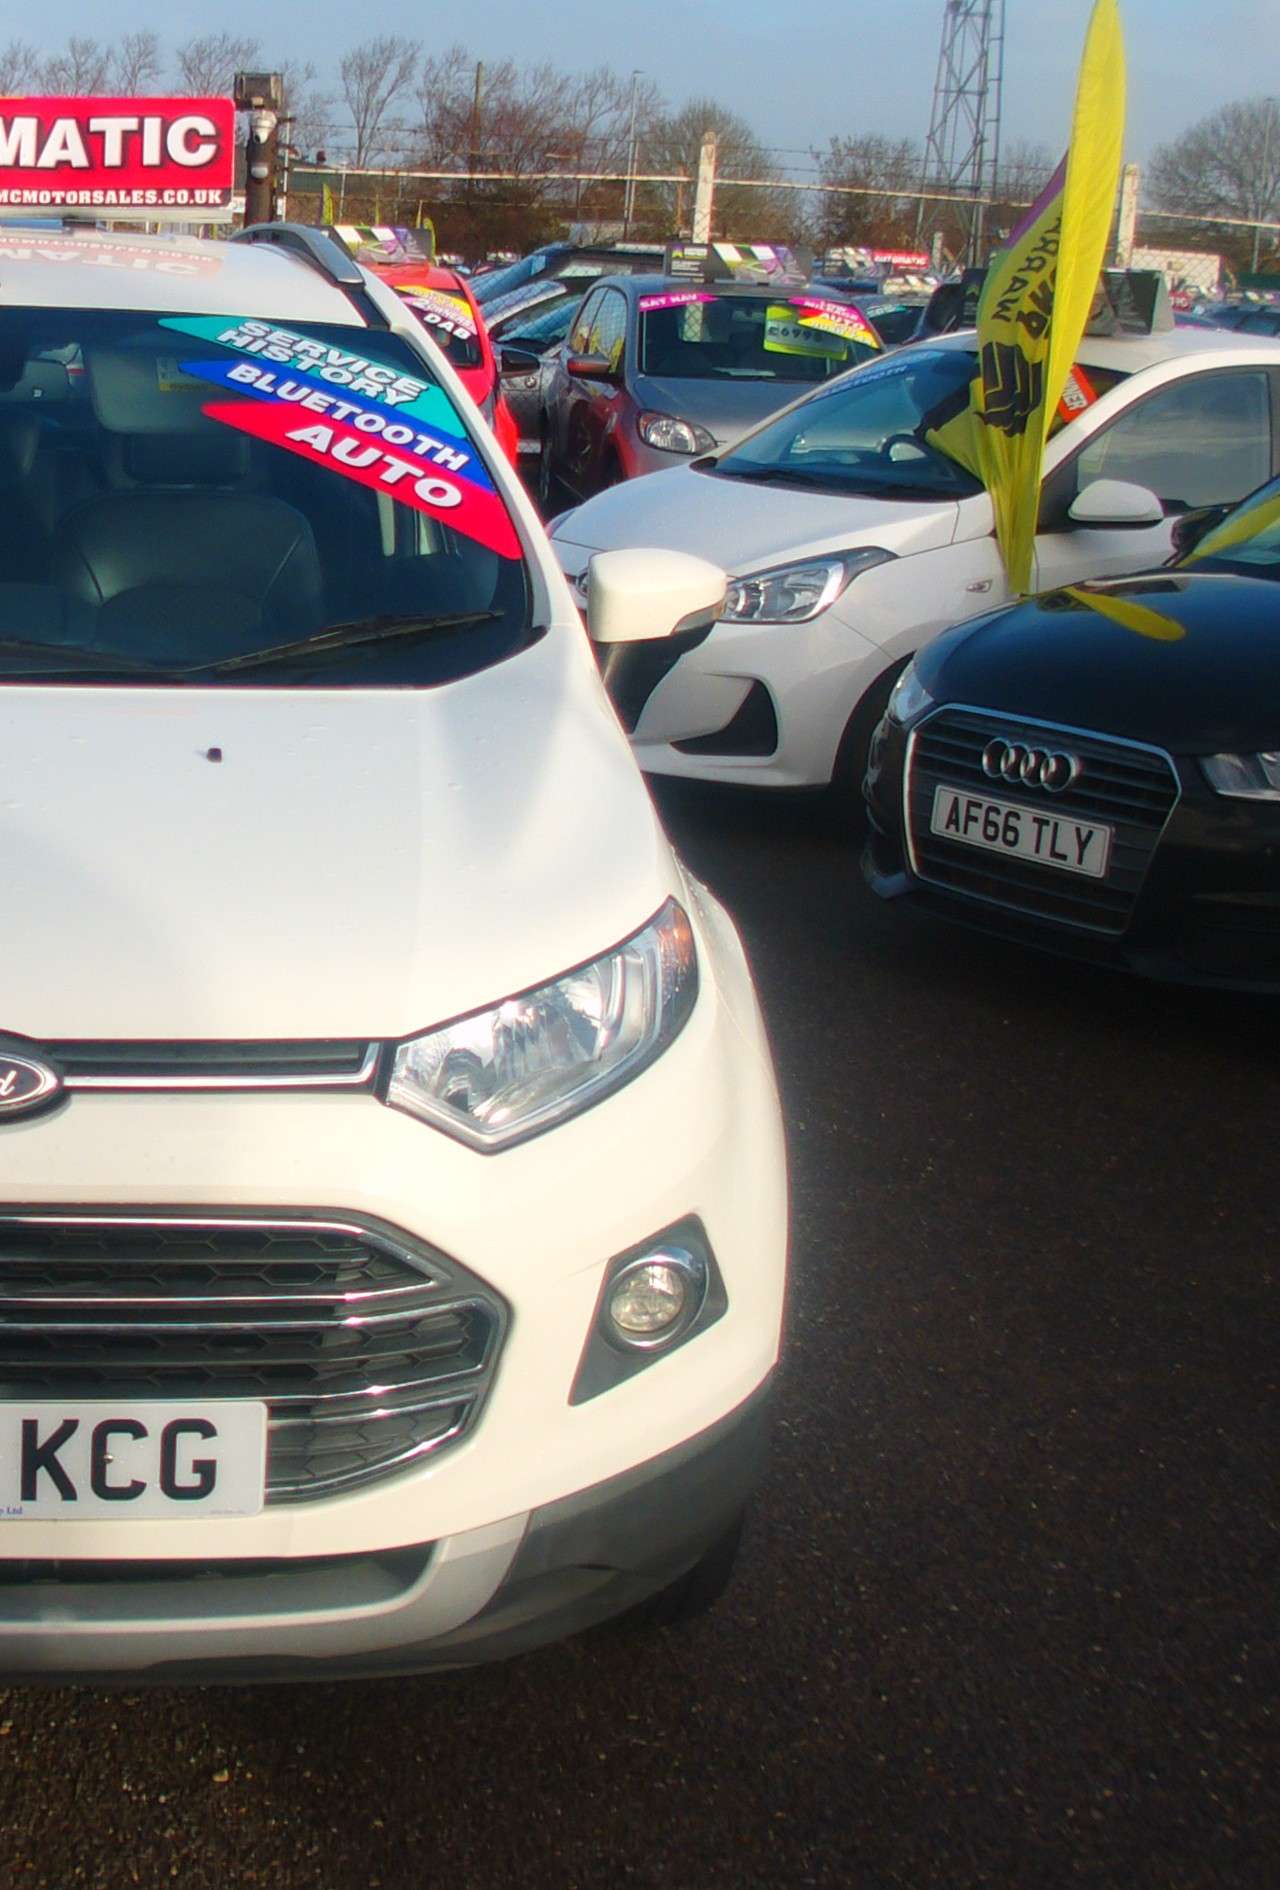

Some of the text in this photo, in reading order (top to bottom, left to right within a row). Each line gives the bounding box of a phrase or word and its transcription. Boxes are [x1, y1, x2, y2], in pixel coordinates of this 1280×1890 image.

[236, 321, 428, 395] SERVICE
[423, 313, 472, 340] DAB
[216, 329, 417, 406] HISTORY
[226, 363, 470, 472] BLUETOOTH
[284, 425, 463, 508] AUTO
[945, 796, 1094, 866] AF66 TLY
[21, 1417, 218, 1502] KCG
